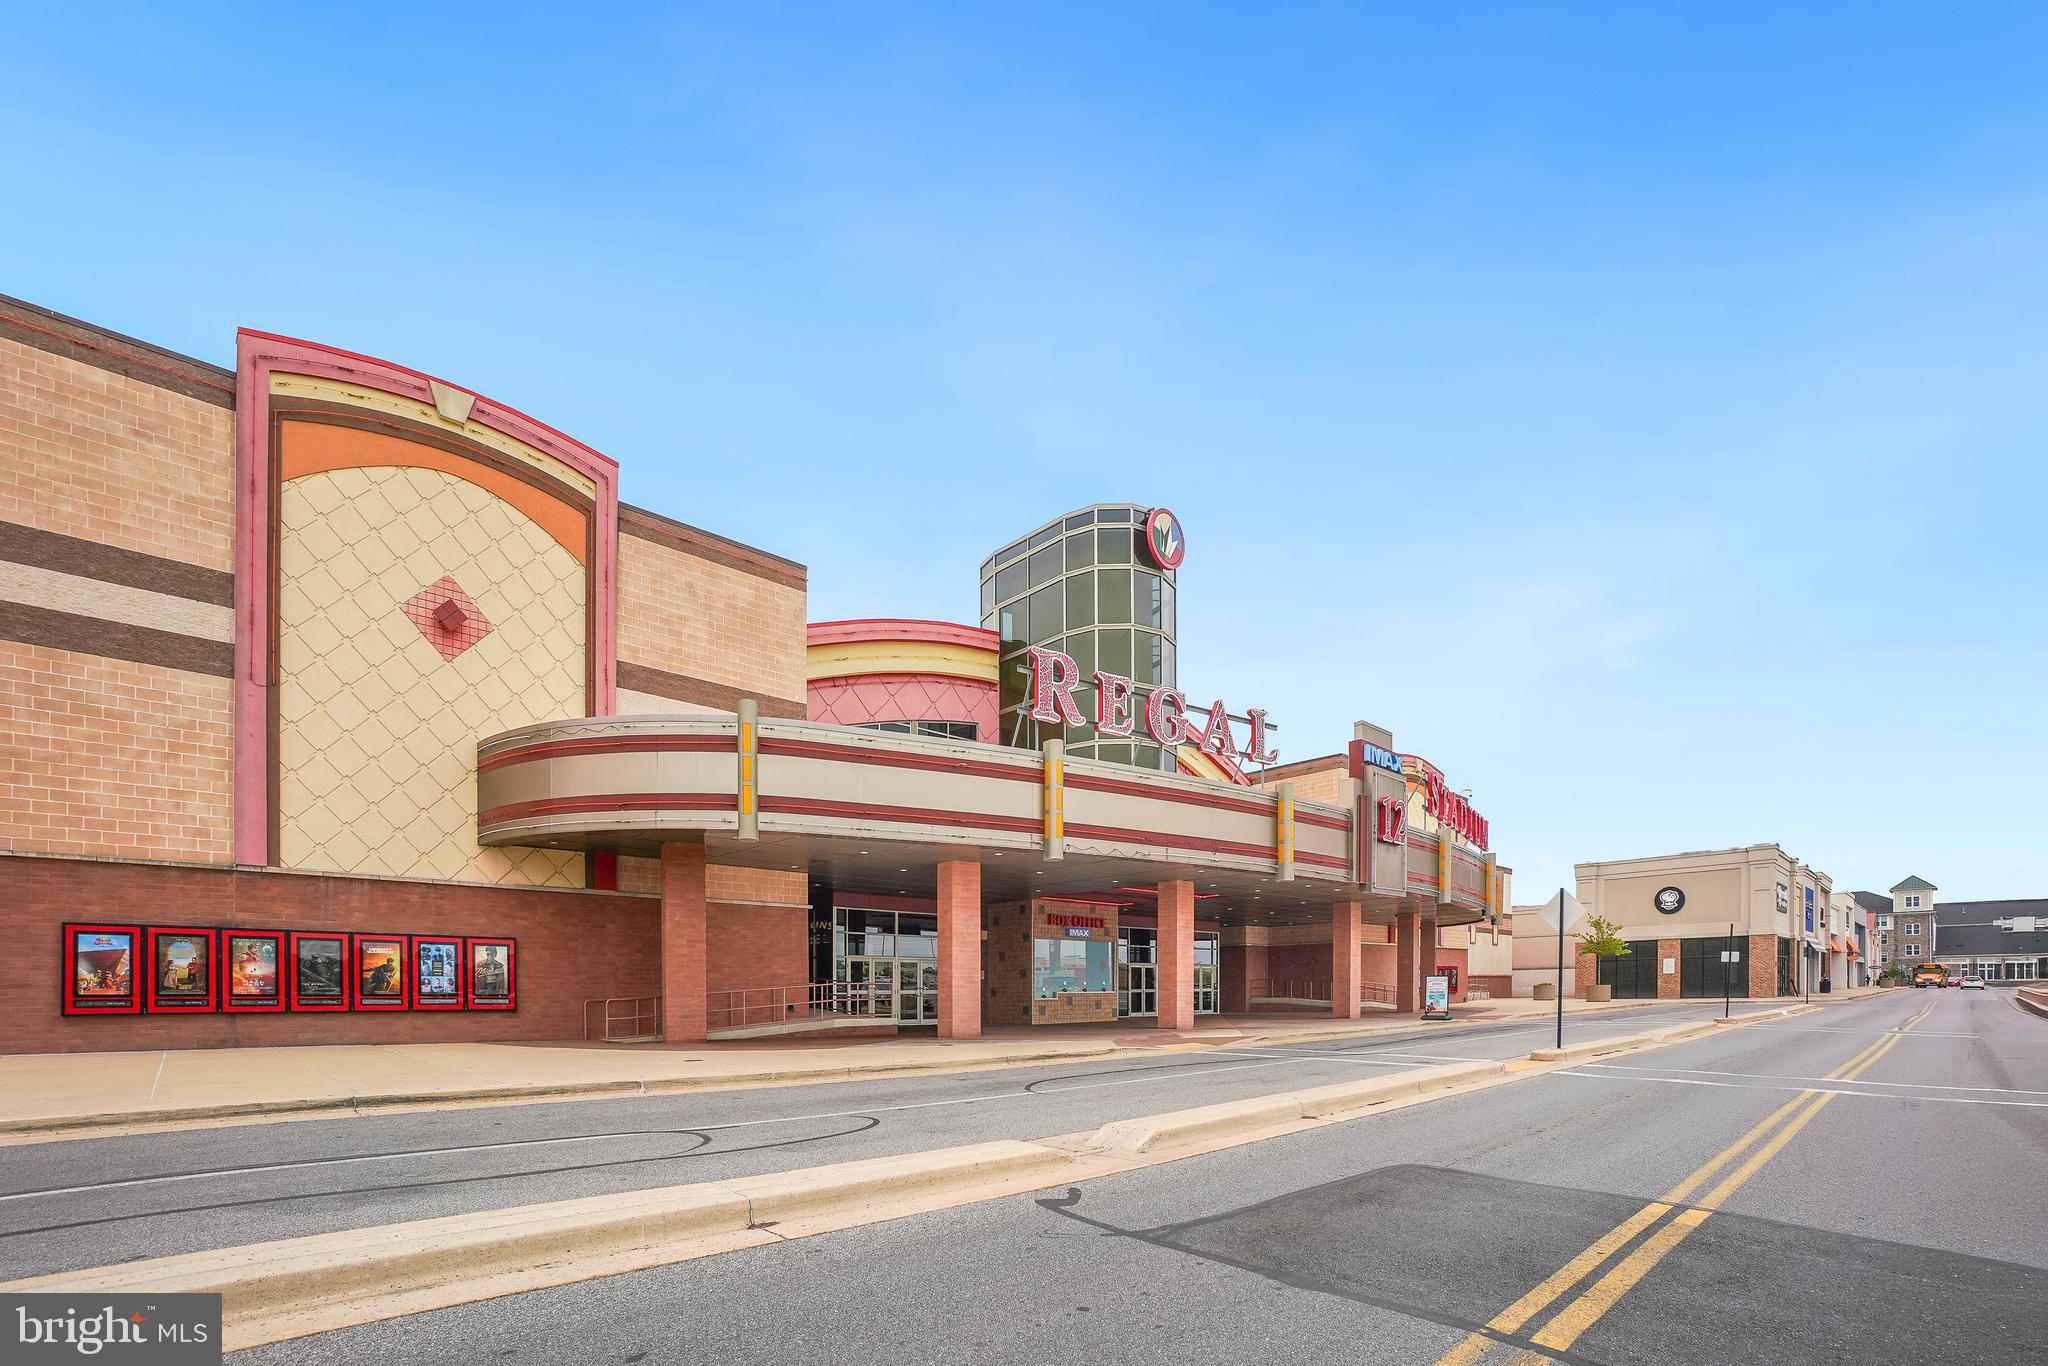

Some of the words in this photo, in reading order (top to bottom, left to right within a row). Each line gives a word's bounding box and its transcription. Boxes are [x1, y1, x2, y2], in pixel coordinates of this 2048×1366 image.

[1028, 646, 1280, 765] REGAL
[1363, 743, 1403, 774] IMAX
[1376, 795, 1407, 845] 12
[1047, 913, 1071, 927] BOX
[1071, 915, 1109, 928] OFFICE
[1069, 928, 1089, 936] IMAX
